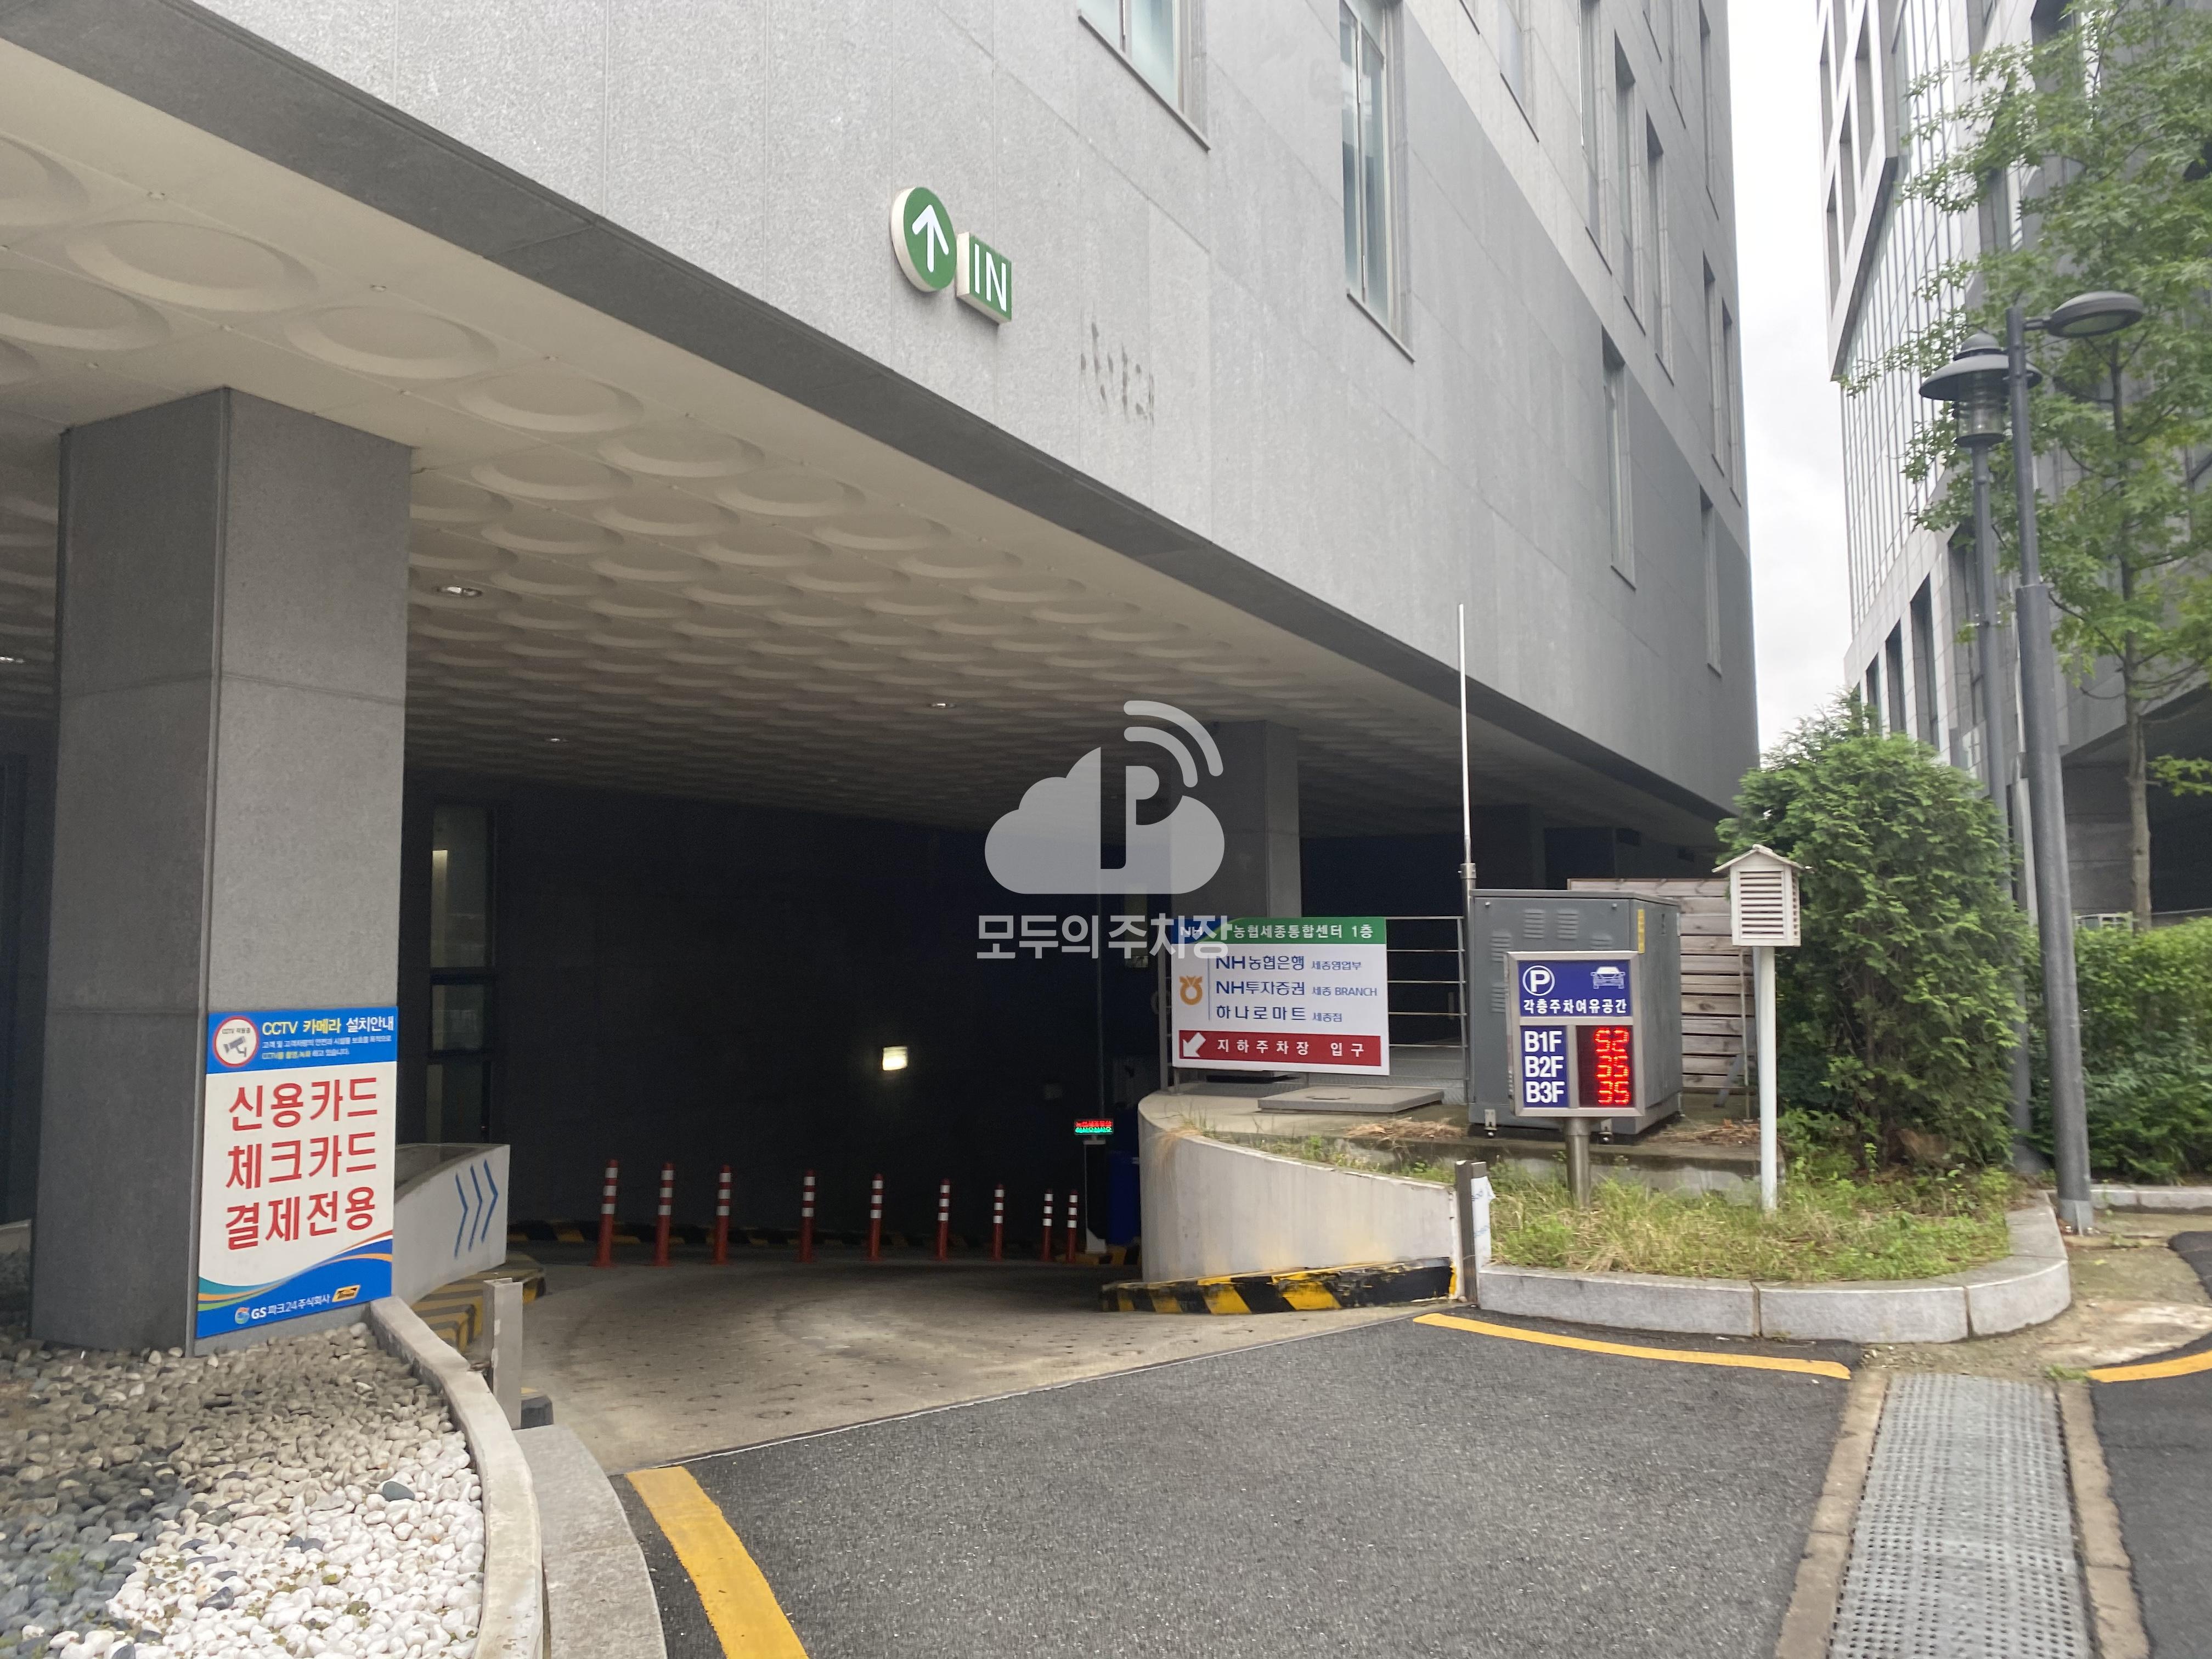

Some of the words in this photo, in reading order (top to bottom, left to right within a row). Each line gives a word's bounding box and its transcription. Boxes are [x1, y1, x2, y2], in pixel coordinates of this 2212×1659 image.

[974, 243, 1007, 312] IN
[1180, 926, 1203, 936] NH
[1233, 924, 1343, 939] 농협세종통합센터
[1351, 924, 1374, 939] 1층
[1311, 960, 1362, 971] 세종영업부
[1215, 980, 1305, 996] NH투자증권
[1312, 986, 1332, 996] 세종
[1335, 987, 1378, 996] BRANCH
[1529, 969, 1551, 992] P
[1216, 1005, 1307, 1020] 하나로마트
[1312, 1012, 1343, 1023] 세종점
[1523, 998, 1627, 1014] 각층주차여유공간
[262, 1021, 298, 1036] CCTV
[302, 1018, 342, 1035] 카메라
[345, 1015, 394, 1033] 설치안내
[1216, 1039, 1310, 1056] 지하주차장
[1330, 1042, 1364, 1057] 입구
[1524, 1030, 1563, 1052] B1F
[1525, 1055, 1565, 1078] B2F
[1525, 1081, 1565, 1103] B3F
[228, 1077, 378, 1132] 신용카드
[225, 1131, 377, 1190] 체크카드
[225, 1186, 375, 1251] 결제전용
